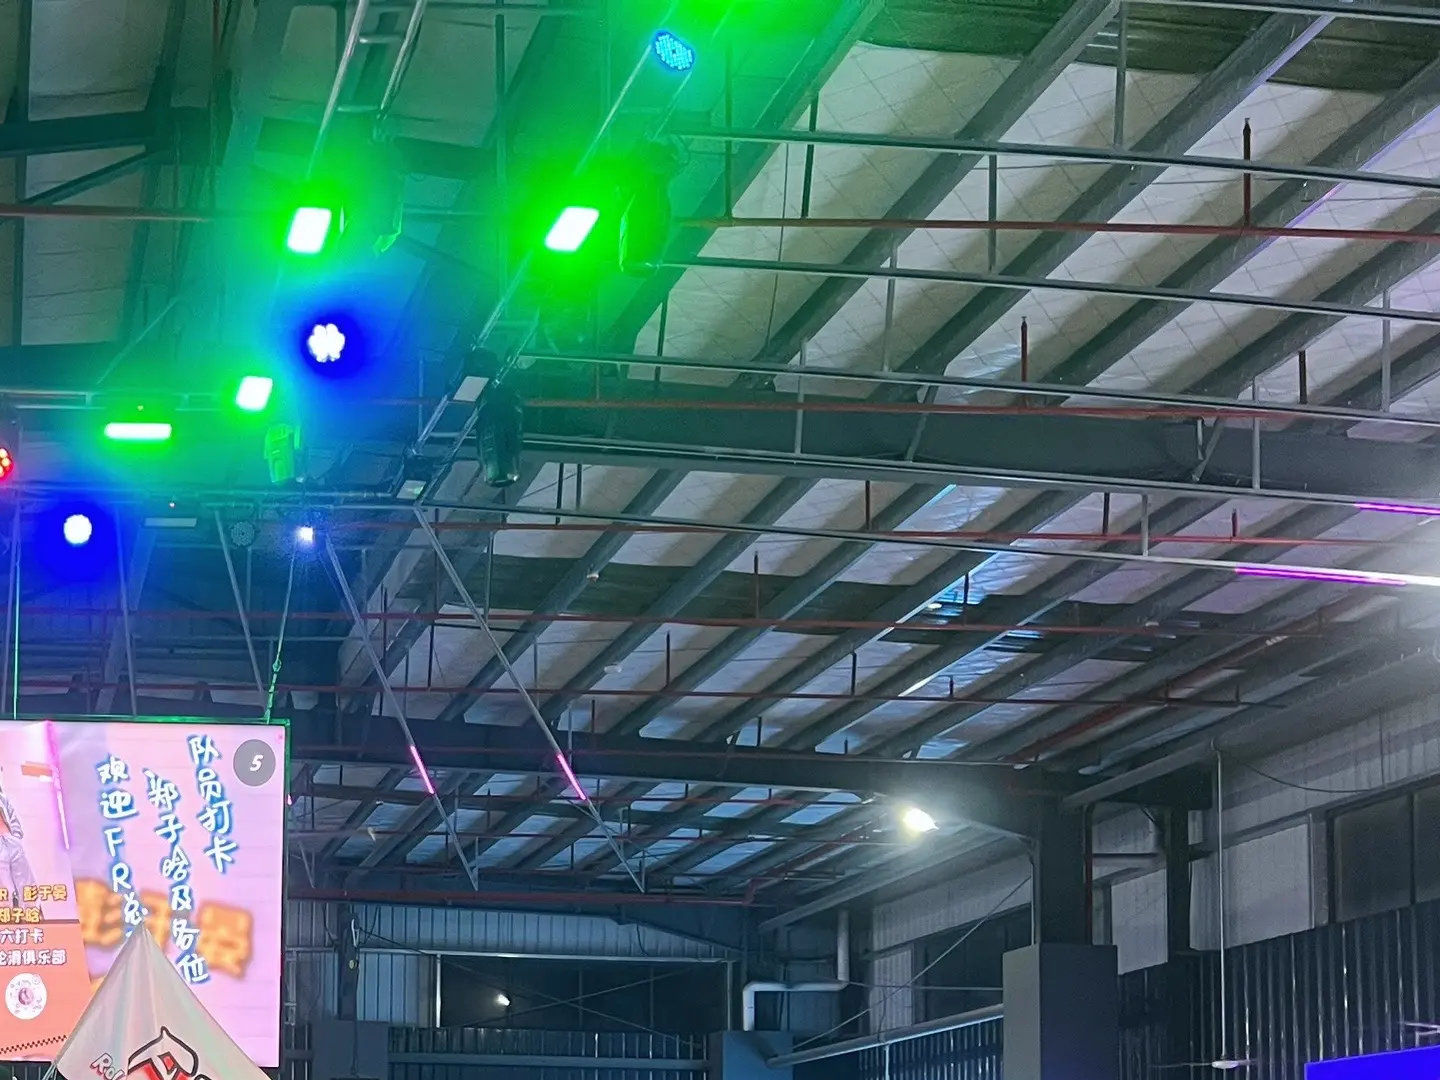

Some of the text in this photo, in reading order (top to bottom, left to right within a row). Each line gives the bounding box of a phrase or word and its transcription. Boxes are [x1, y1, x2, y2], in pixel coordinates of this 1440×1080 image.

[189, 735, 237, 872] 队员打卡
[250, 754, 263, 772] 5
[97, 756, 148, 936] 欢迎FR总
